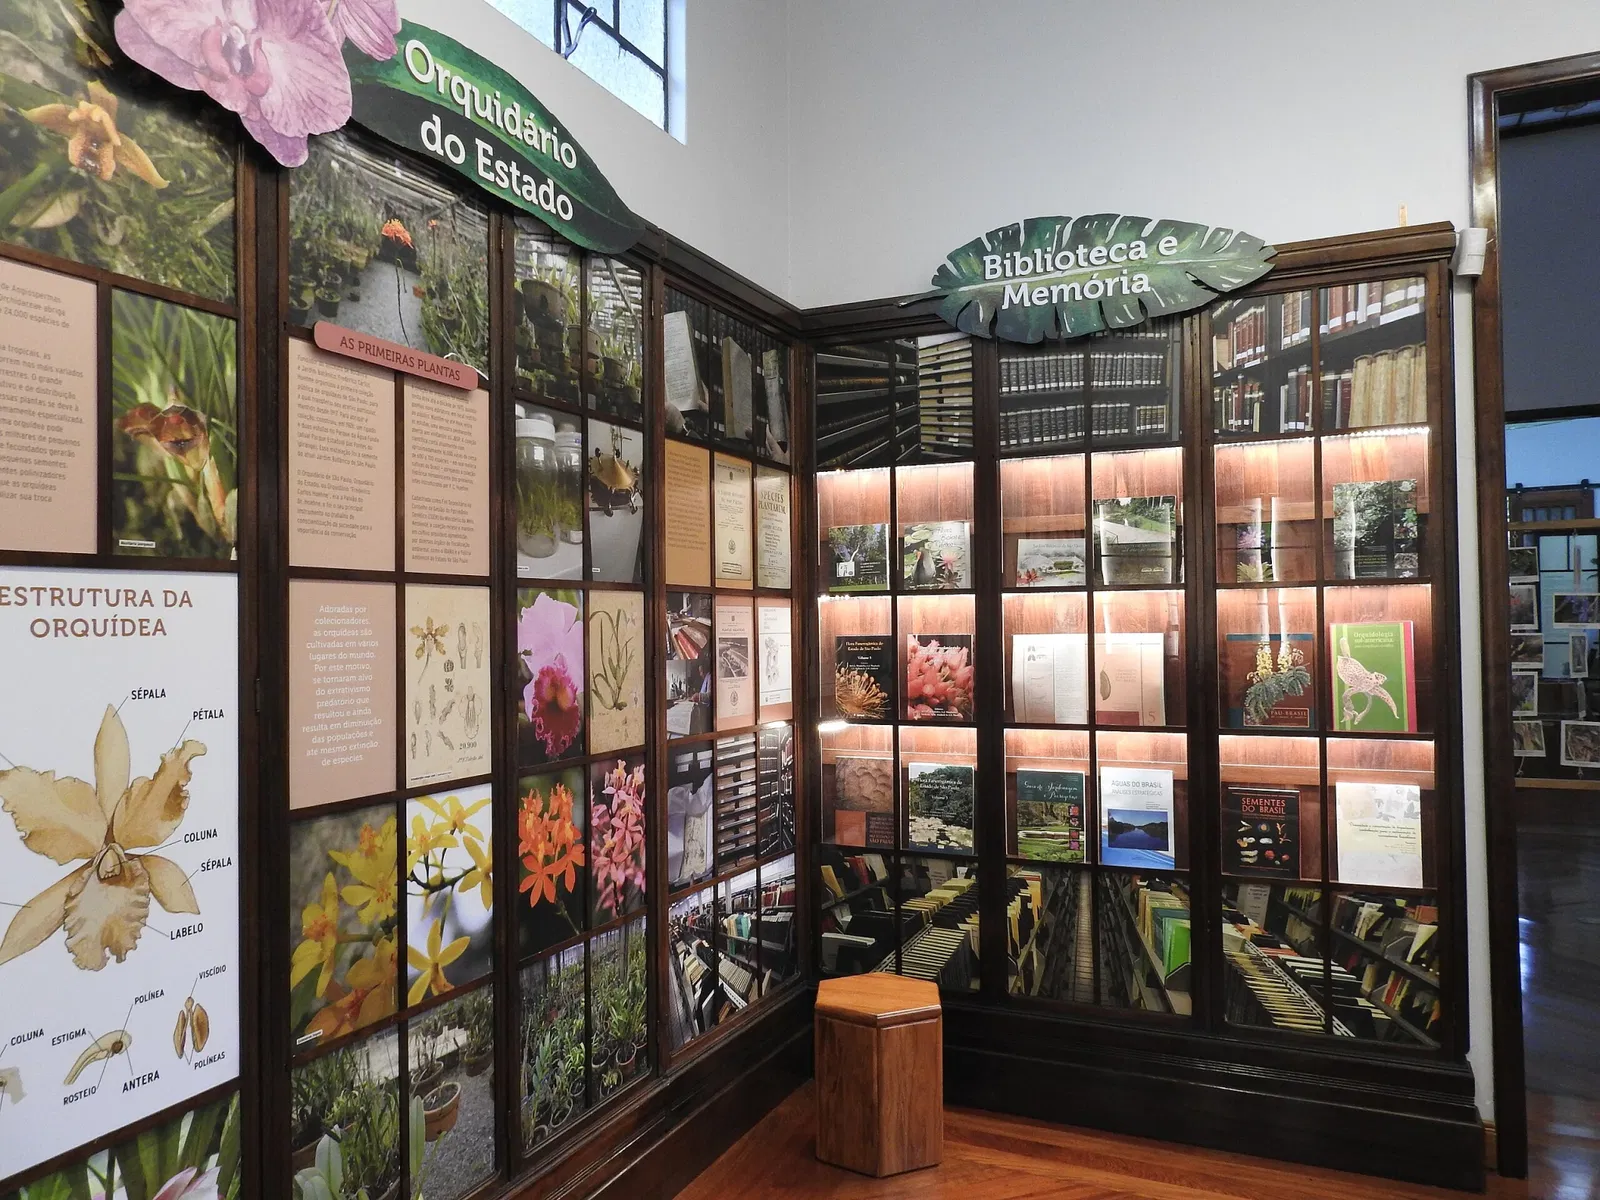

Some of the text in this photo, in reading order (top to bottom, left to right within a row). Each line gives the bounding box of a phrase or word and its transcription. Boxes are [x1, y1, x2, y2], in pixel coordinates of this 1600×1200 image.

[404, 39, 577, 170] Orquidário
[420, 113, 573, 221] do Estado
[983, 235, 1178, 280] Biblioteca e
[1001, 268, 1151, 310] Memória
[339, 335, 461, 381] AS PRIMEIRAS PLANTAS
[0, 586, 193, 608] ESTRUTURA DA
[30, 614, 167, 638] ORQUÍDEA
[324, 628, 358, 638] orquídeas
[309, 653, 337, 662] lugares
[314, 664, 327, 672] Por
[323, 675, 356, 683] tornaram
[131, 687, 166, 700] SÉPALA
[316, 686, 371, 696] do extrativismo
[356, 697, 370, 706] que
[193, 708, 224, 720] PÉTALA
[314, 711, 344, 719] resultou
[352, 707, 372, 716] ainda
[302, 724, 328, 732] resulta
[343, 717, 382, 728] diminuição
[320, 746, 347, 754] mesmo
[321, 758, 331, 766] de
[1242, 798, 1286, 807] SEMENTES
[1242, 805, 1286, 814] DO BRASIL
[183, 828, 218, 843] COLUNA
[200, 856, 232, 872] SÉPALA
[170, 922, 204, 941] LABELO
[198, 964, 227, 980] VISCÍDIO
[134, 988, 165, 1005] POLÍNEA
[10, 1028, 45, 1047] COLUNA
[51, 1028, 87, 1046] ESTIGMA
[193, 1051, 226, 1070] POLÍNEAS
[122, 1070, 160, 1093] ANTERA
[63, 1085, 97, 1105] ROSTEIO
